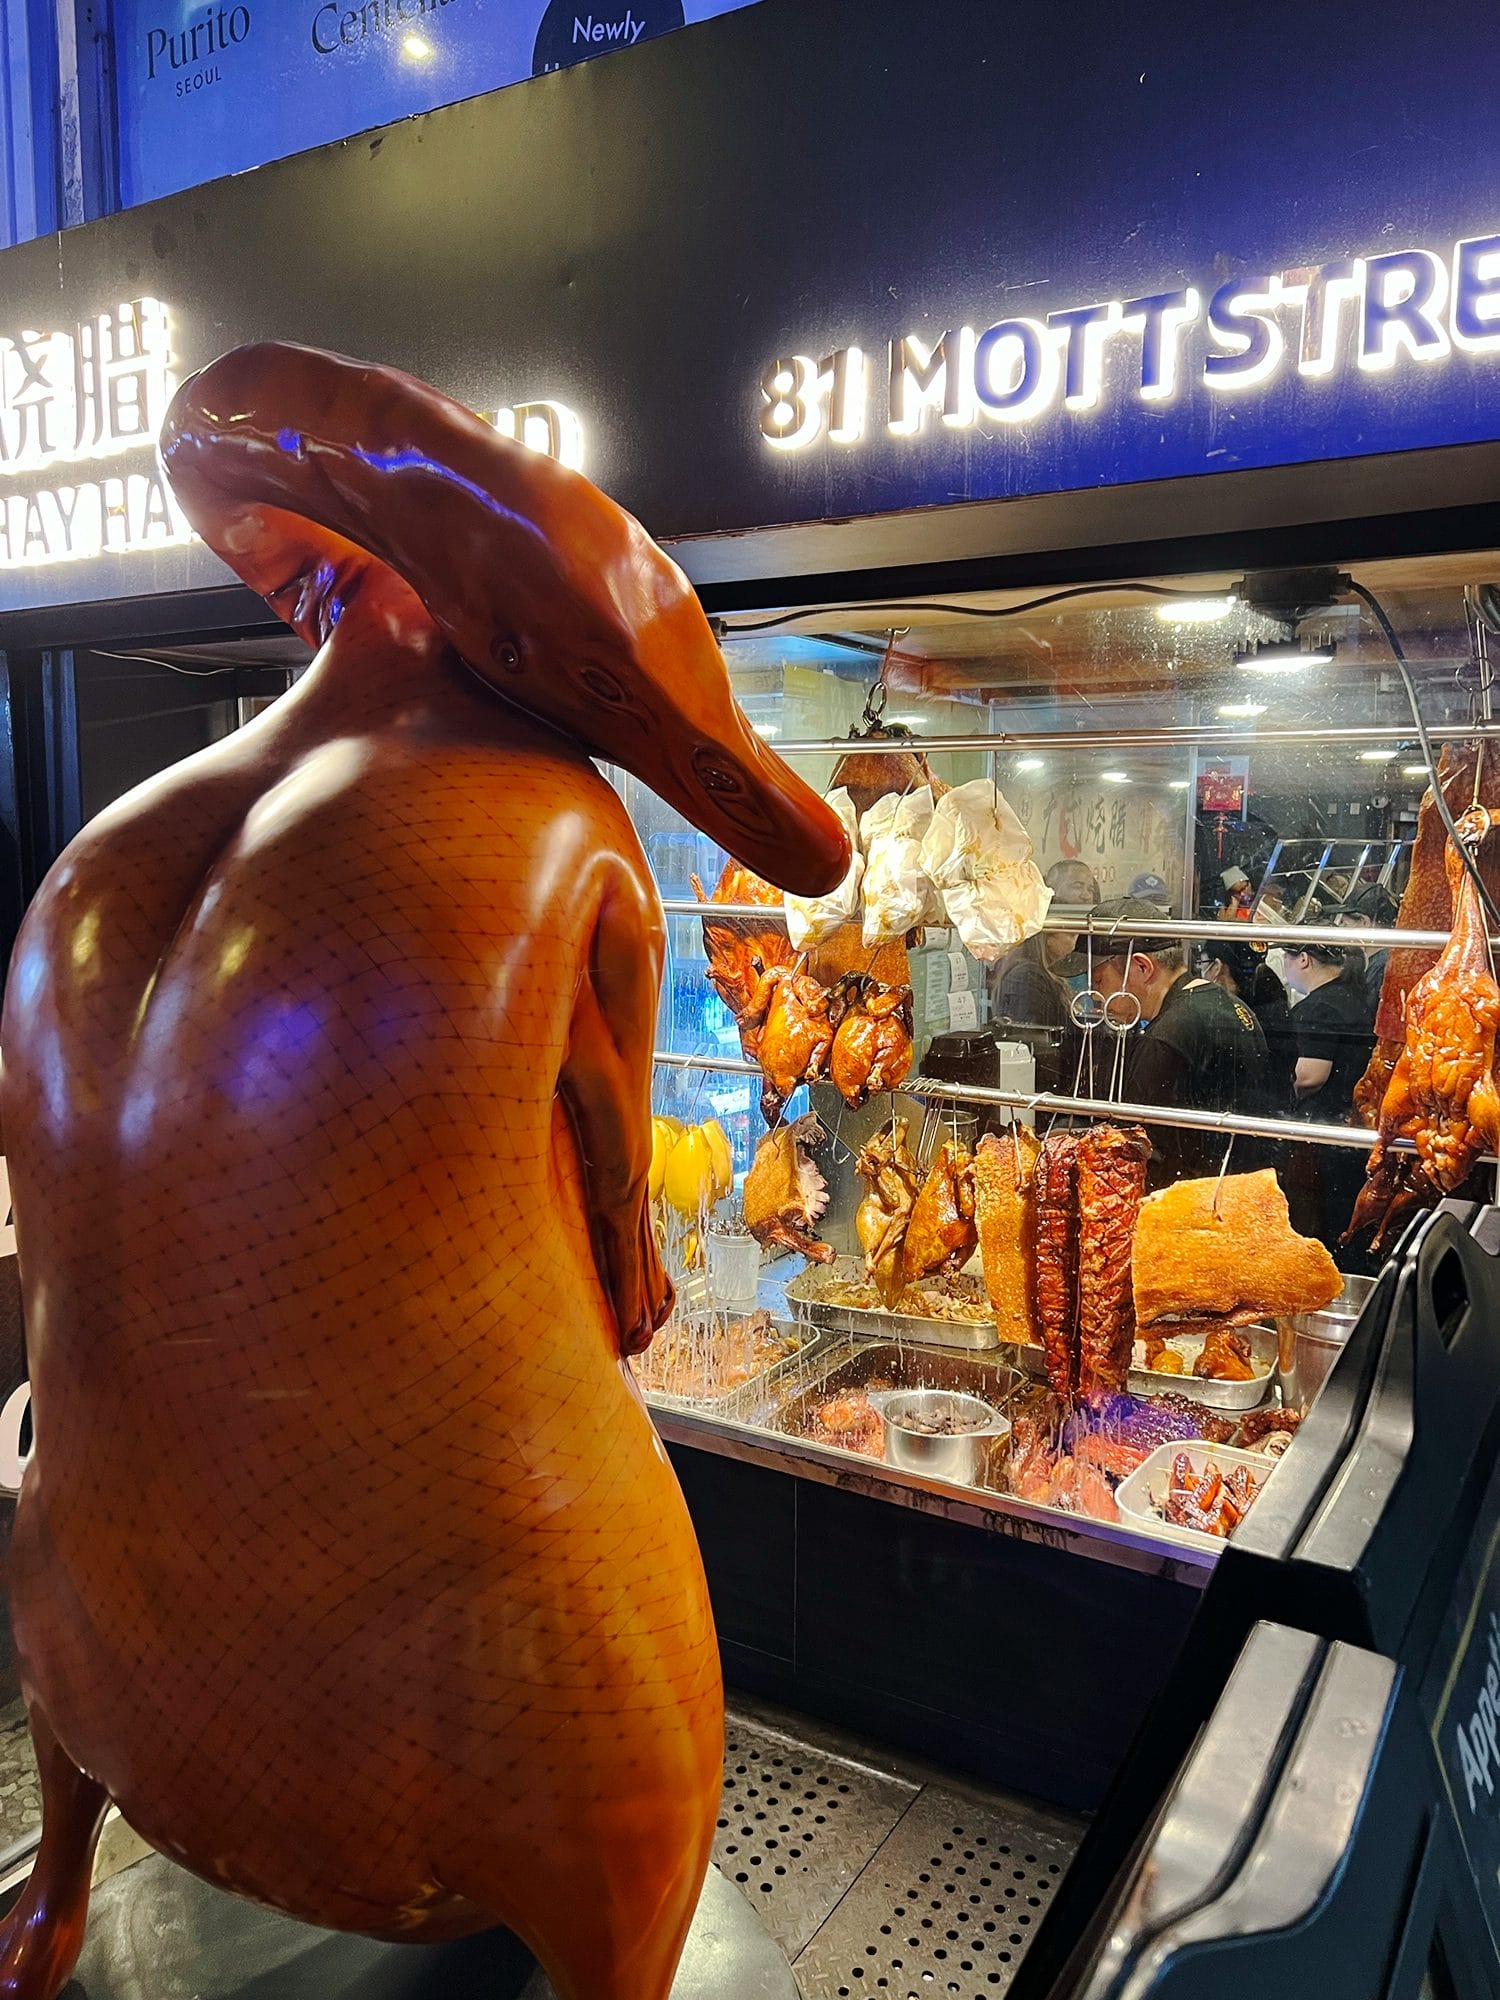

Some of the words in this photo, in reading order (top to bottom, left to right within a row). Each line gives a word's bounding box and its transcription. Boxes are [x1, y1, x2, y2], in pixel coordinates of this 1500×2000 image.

[146, 4, 250, 80] Purito
[572, 9, 646, 44] Newly
[176, 66, 222, 98] SEOUL
[759, 346, 862, 448] 81
[888, 289, 1198, 433] MOTT
[1204, 236, 1500, 386] STRE
